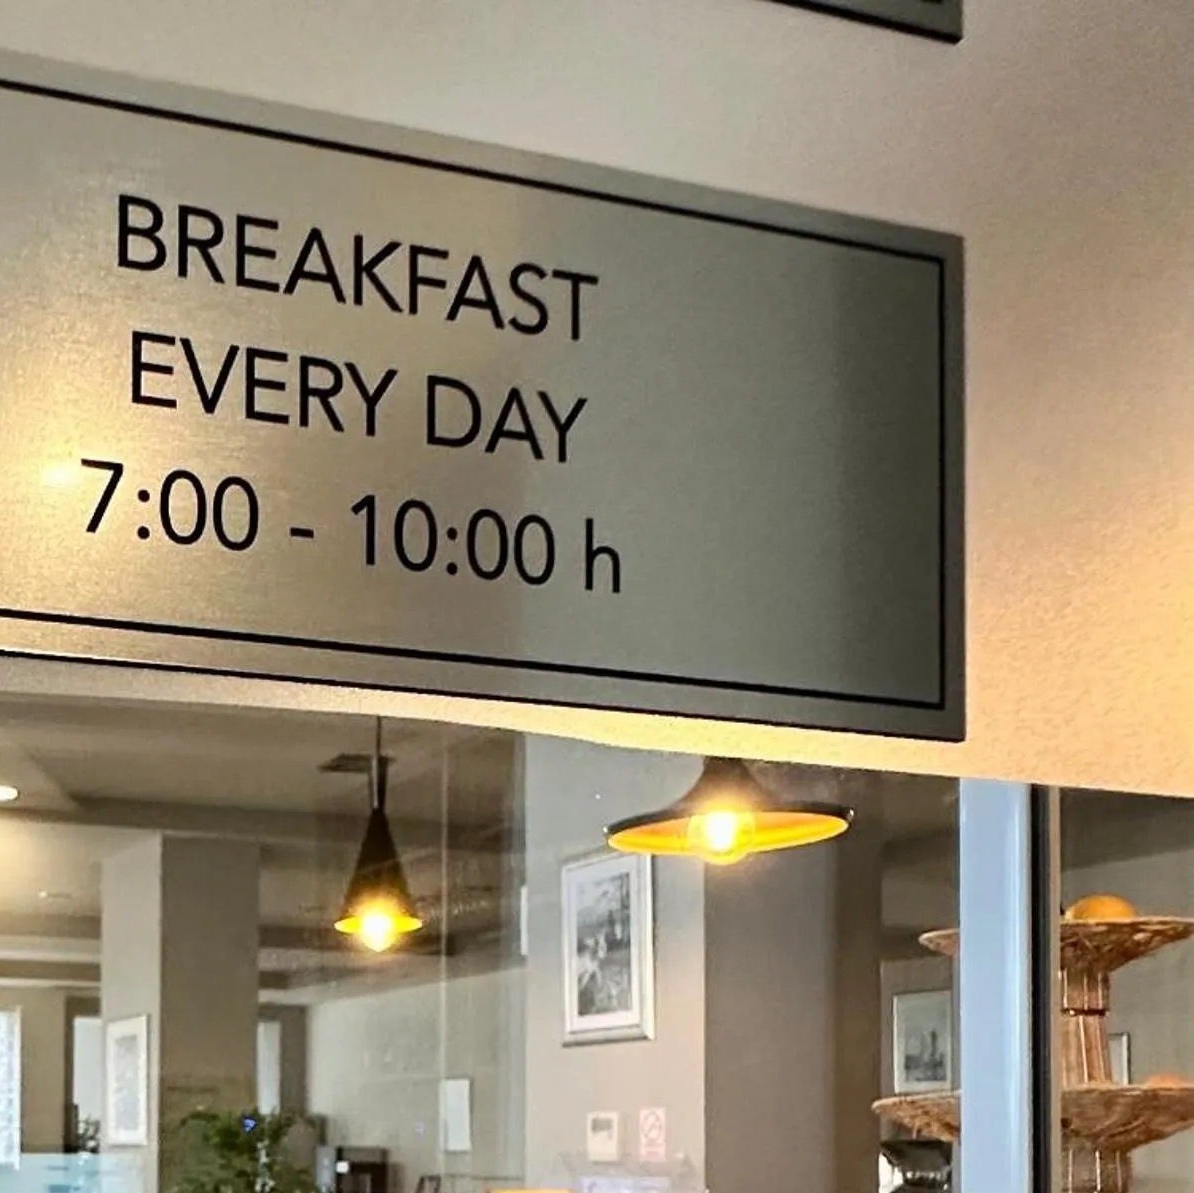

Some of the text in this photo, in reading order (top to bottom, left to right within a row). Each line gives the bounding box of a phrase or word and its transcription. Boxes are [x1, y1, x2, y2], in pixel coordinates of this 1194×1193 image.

[116, 193, 599, 341] BREAKFAST
[130, 330, 588, 463] EVERY DAY
[80, 458, 621, 594] 7:00 - 10:00 h
